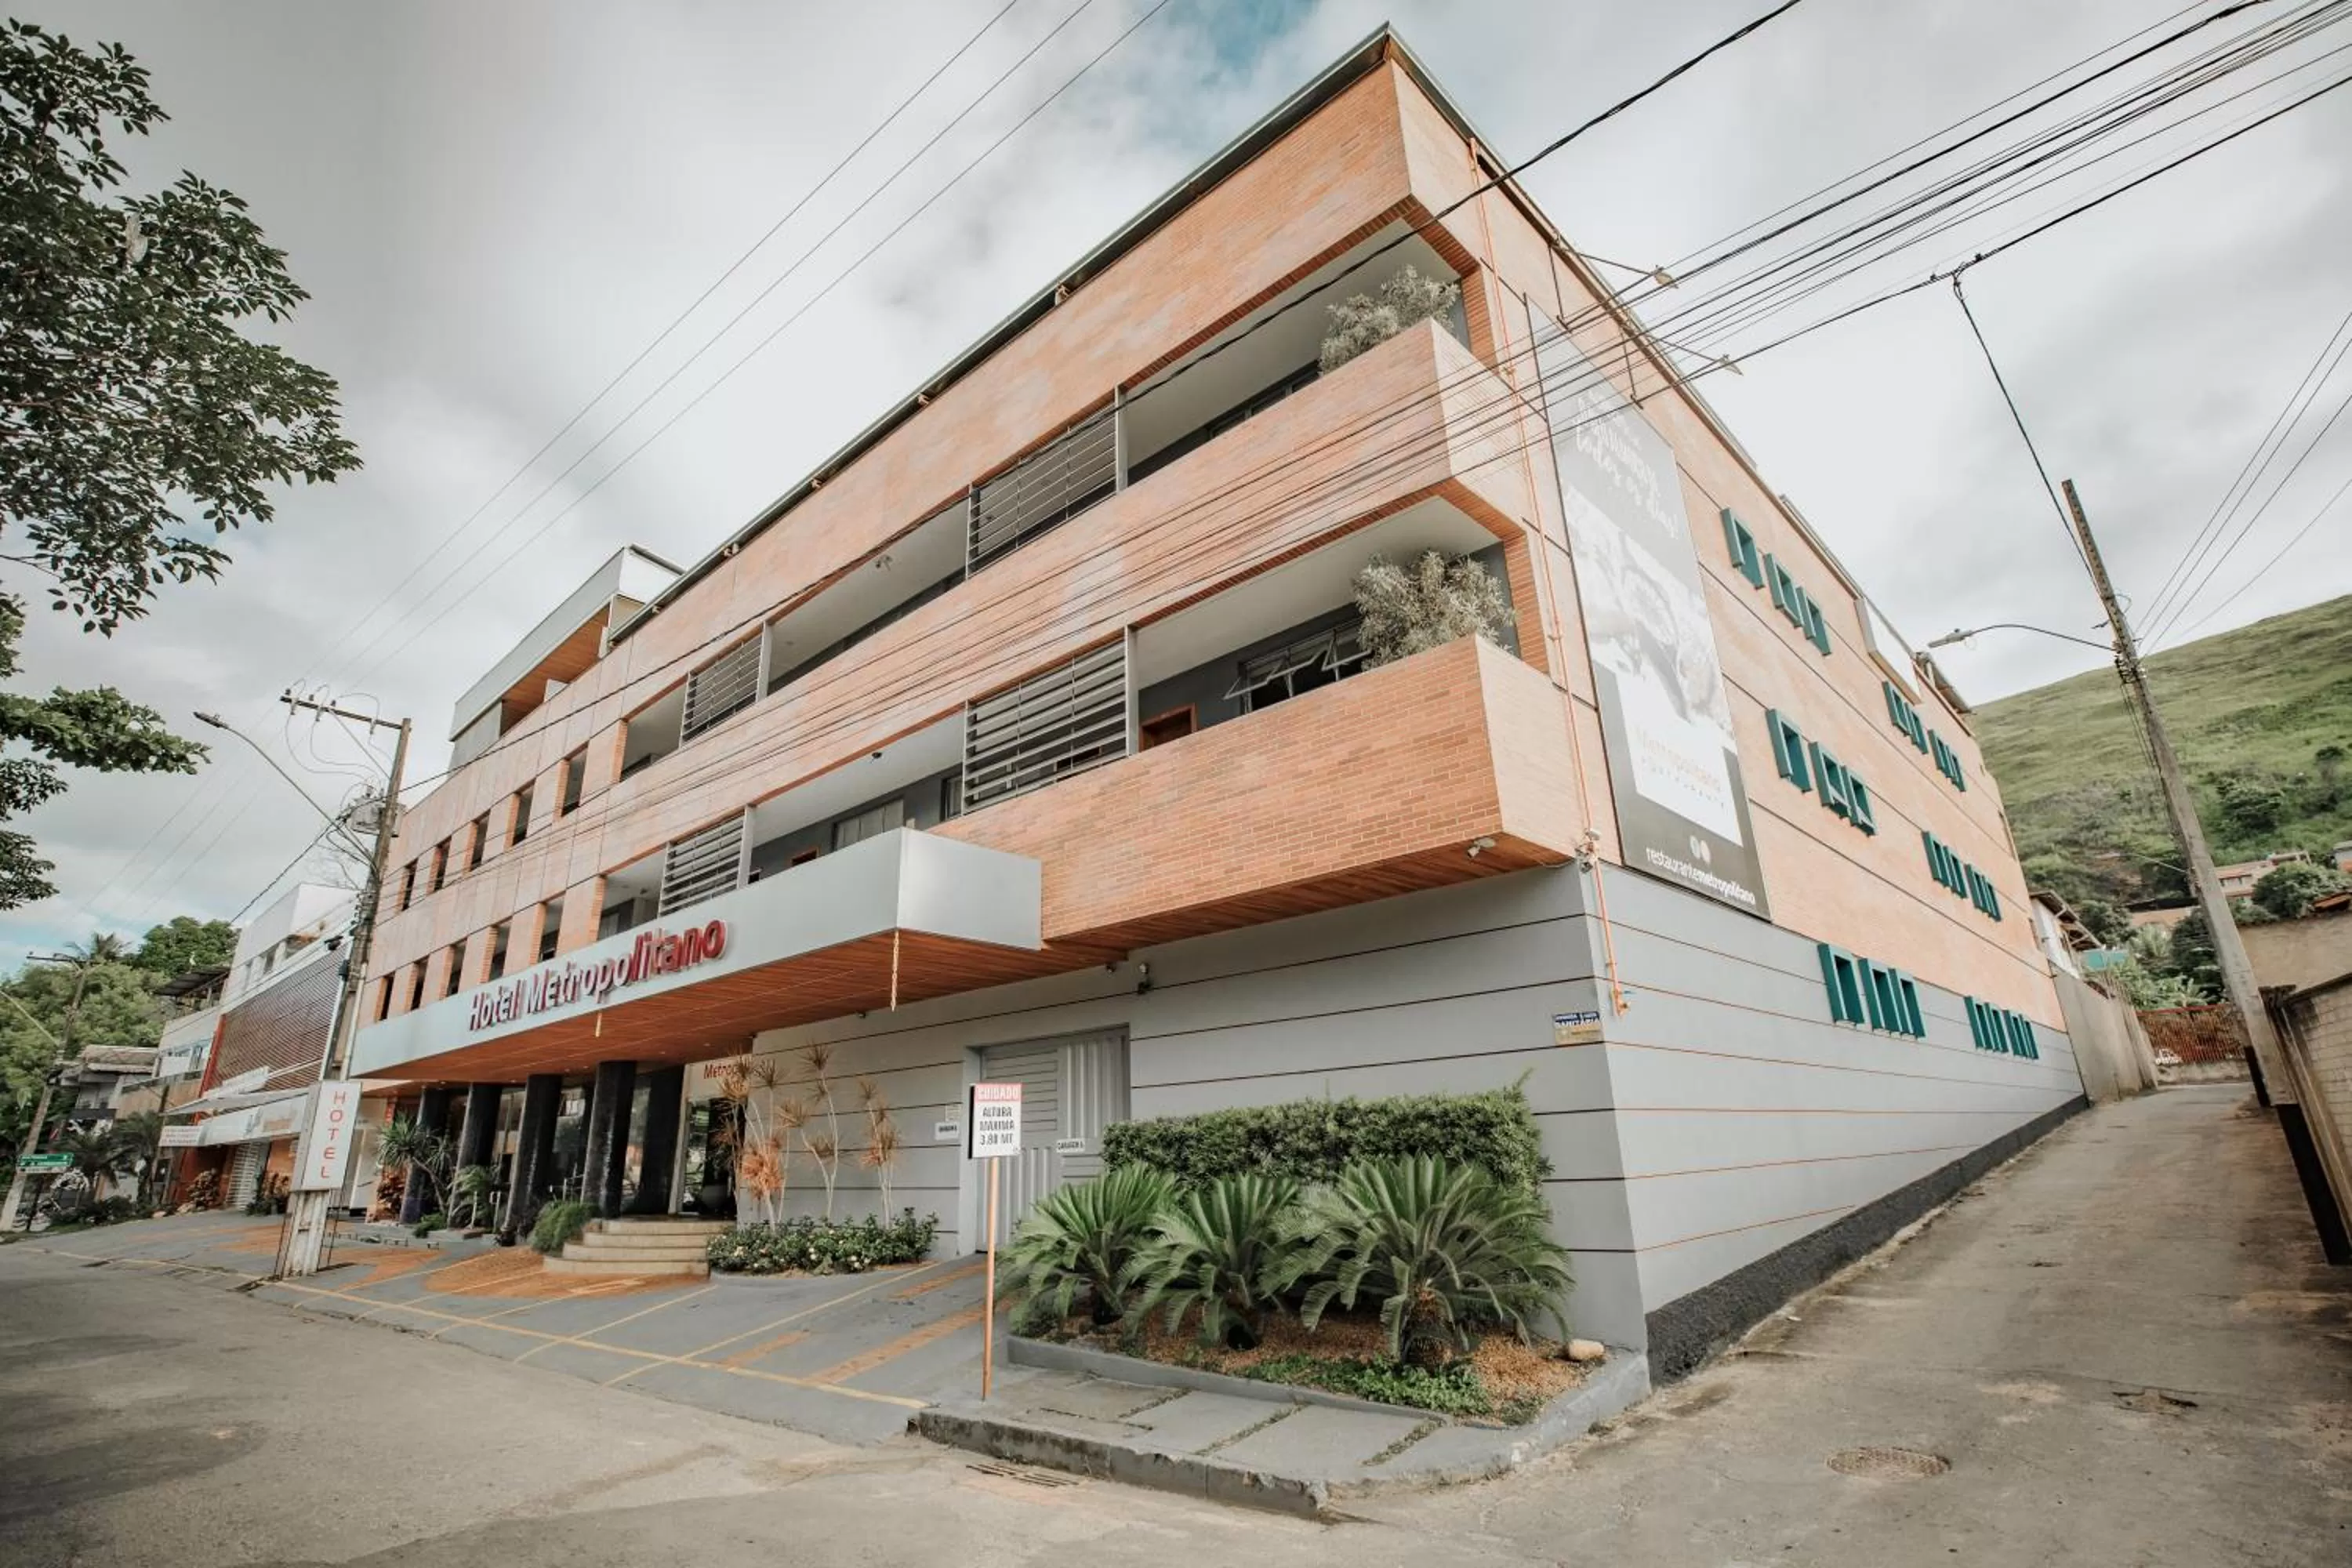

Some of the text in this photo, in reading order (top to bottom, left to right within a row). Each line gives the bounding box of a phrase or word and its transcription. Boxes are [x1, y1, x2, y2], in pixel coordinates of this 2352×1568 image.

[470, 919, 728, 1031] Hotel Metropolitano
[320, 1091, 346, 1179] HOTEL
[978, 1087, 1018, 1100] CUIDADO
